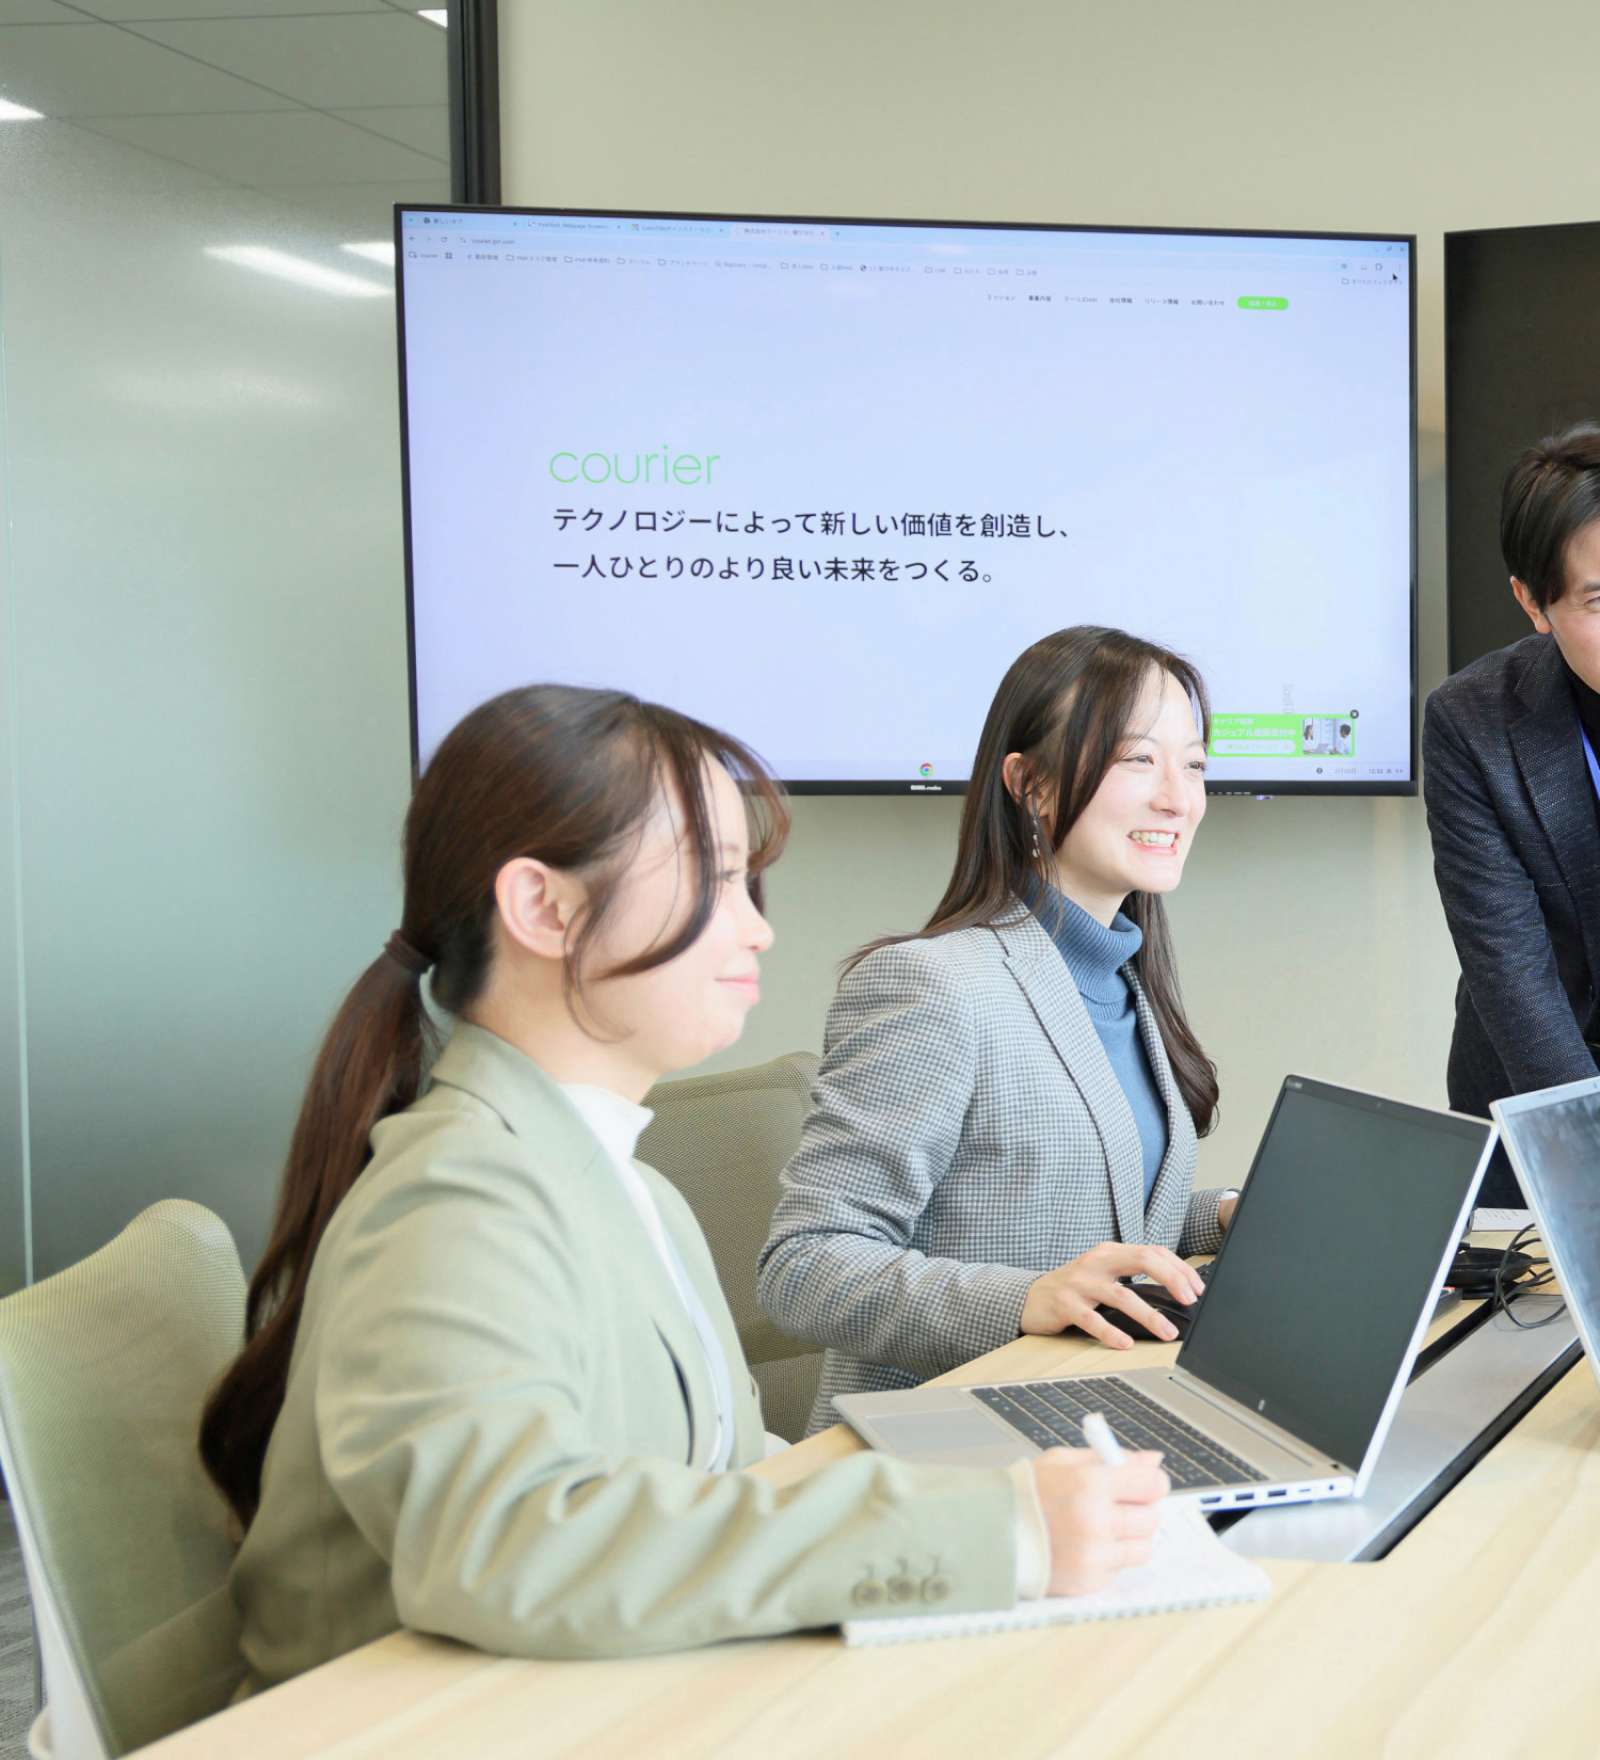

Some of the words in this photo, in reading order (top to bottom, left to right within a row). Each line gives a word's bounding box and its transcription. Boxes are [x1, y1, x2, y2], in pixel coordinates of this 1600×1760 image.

[549, 445, 721, 485] courier
[552, 506, 1073, 540] テクノロジーによって新しい価値を創造し、
[552, 555, 994, 585] 一人ひとりのより良い未来をつくる。
